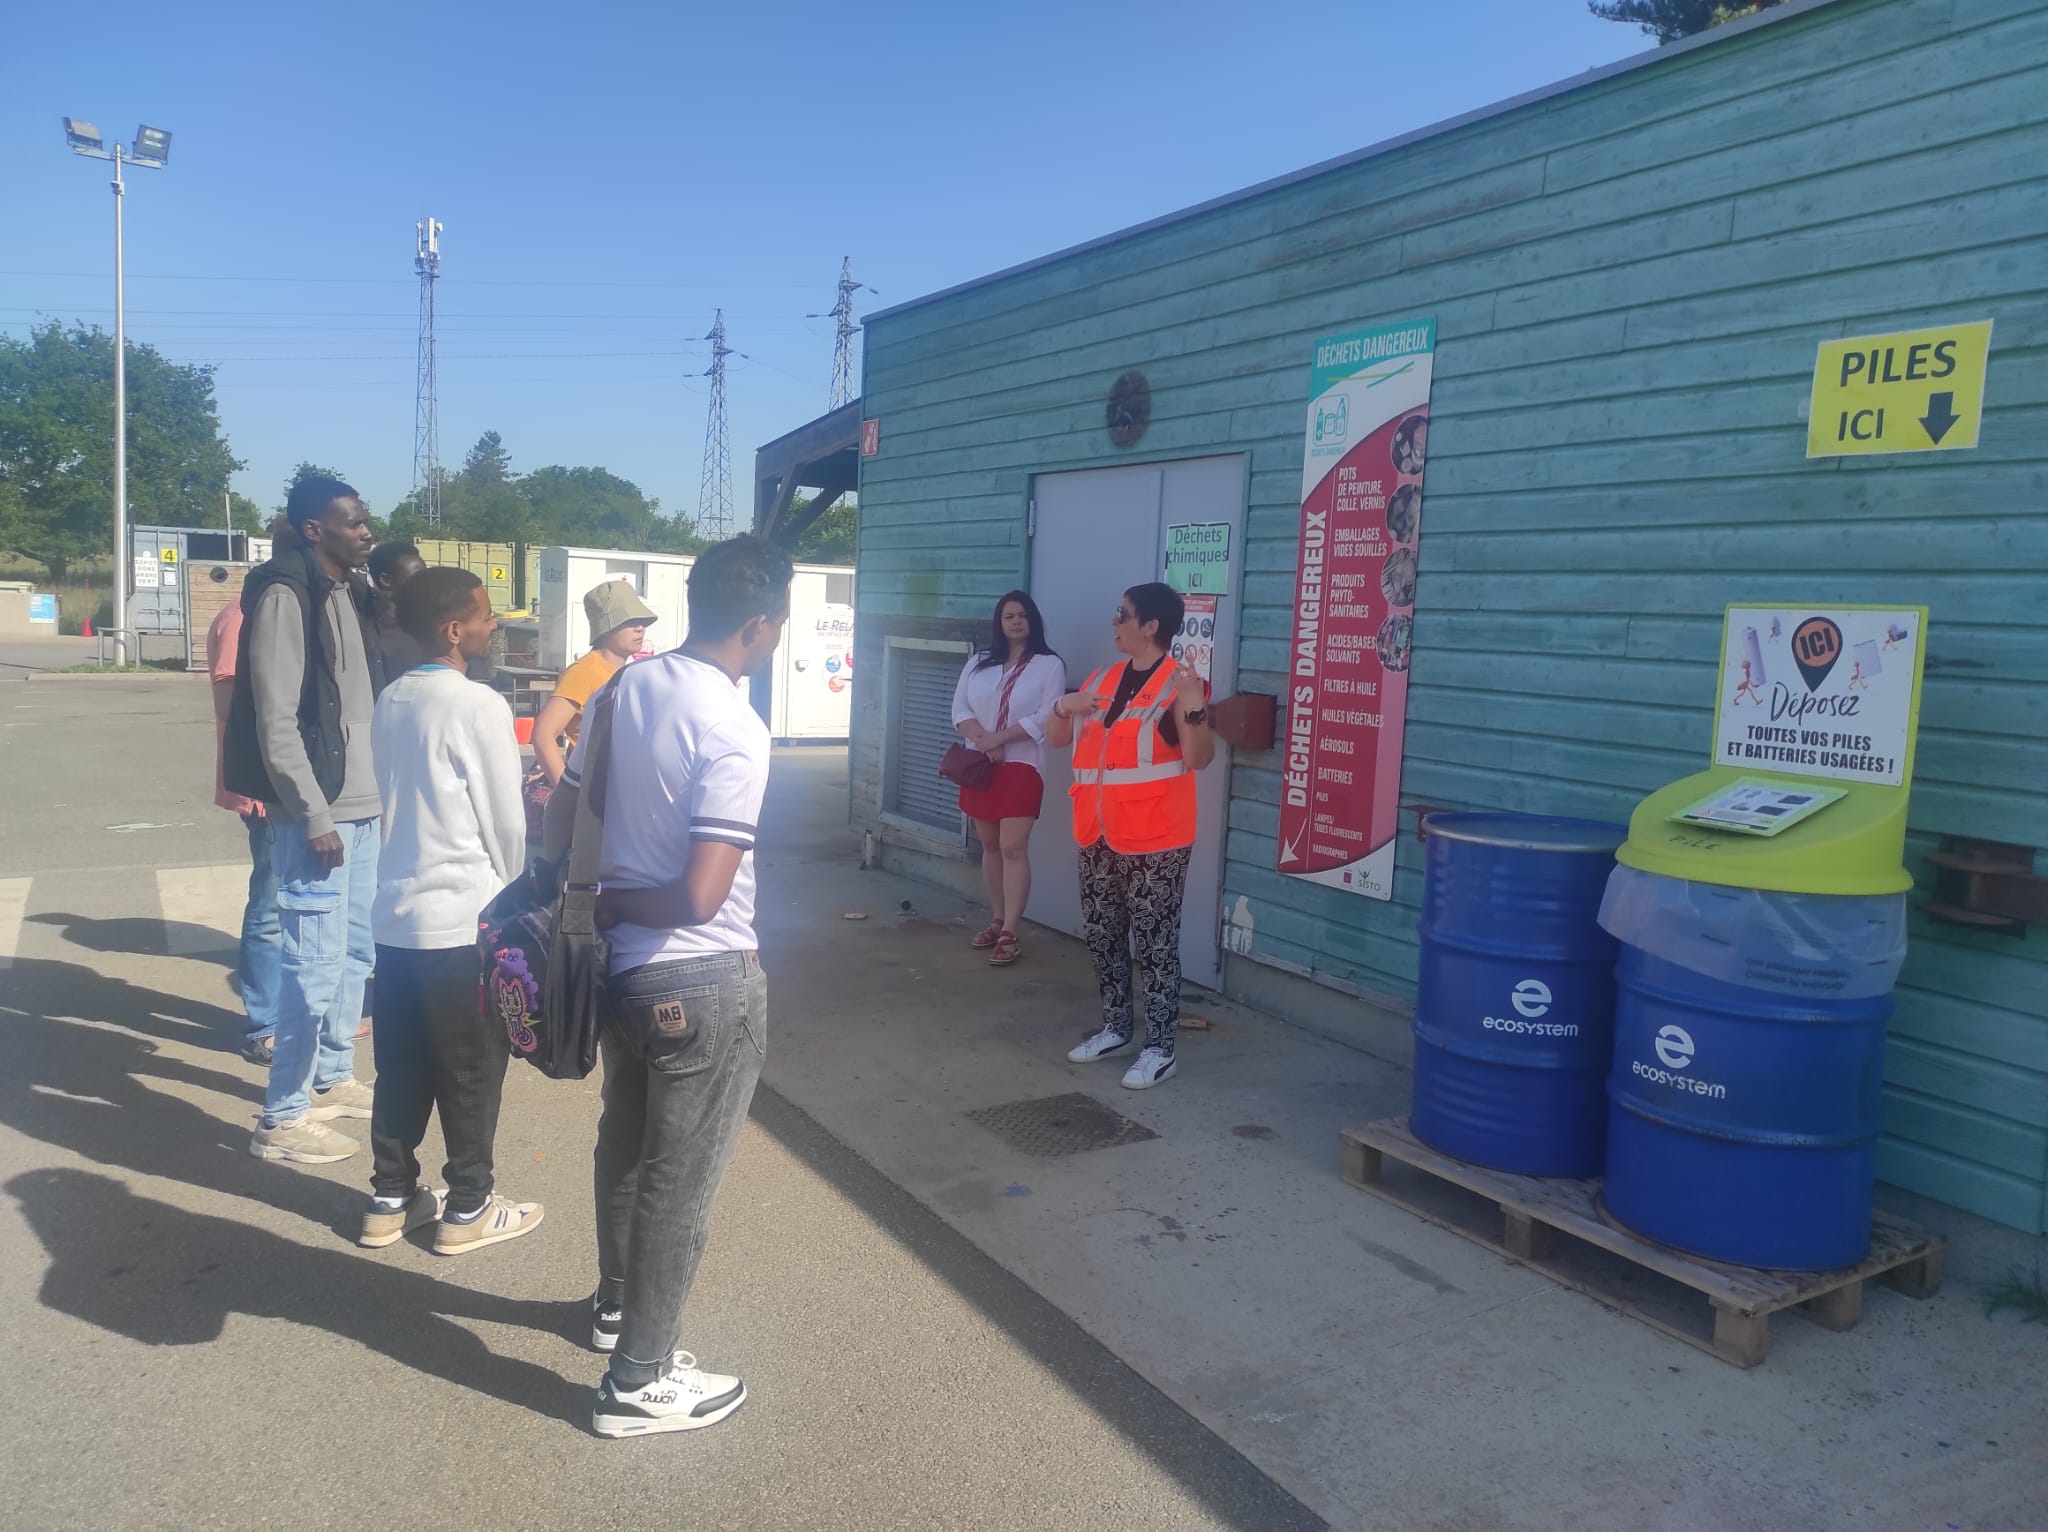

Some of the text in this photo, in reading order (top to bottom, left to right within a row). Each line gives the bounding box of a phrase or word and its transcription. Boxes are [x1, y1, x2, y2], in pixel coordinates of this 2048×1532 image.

[1317, 327, 1429, 368] DÉCHETS DANGEREUX
[1840, 340, 1957, 387] PILES
[1838, 408, 1884, 441] ICI
[1339, 466, 1357, 481] POTS
[1338, 484, 1347, 496] DE
[1360, 496, 1385, 510] VERNIS
[1175, 527, 1222, 544] Déchets
[1335, 527, 1380, 542] EMBALLAGES
[164, 550, 174, 561] 4
[1168, 547, 1228, 567] chimiques
[1334, 543, 1353, 557] VIDES
[495, 568, 503, 580] 2
[1188, 573, 1202, 588] ICI
[1331, 574, 1365, 588] PRODUITS
[1330, 589, 1355, 602] PHYTO-
[1329, 605, 1369, 618] SANITAIRES
[816, 619, 829, 630] LE
[1799, 627, 1835, 660] ICI
[1284, 510, 1327, 807] DÉCHETS DANGEREUX
[1326, 649, 1361, 664] SOLVANTS
[1324, 678, 1348, 693] FILTRES
[1357, 681, 1377, 696] HUILE
[1769, 681, 1860, 726] Déposez
[1322, 708, 1385, 728] HUILES VÉGÉTALES
[1319, 735, 1355, 754] AÉROSOLS
[1747, 725, 1872, 751] TOUTES VOS PILES
[1727, 742, 1743, 756] ET
[1745, 743, 1818, 765] BATTERIES
[1820, 751, 1885, 773] USAGÉES
[1317, 767, 1353, 785] BATTERIES
[1482, 1016, 1579, 1037] ecosystem
[1632, 1060, 1726, 1100] ecosystem
